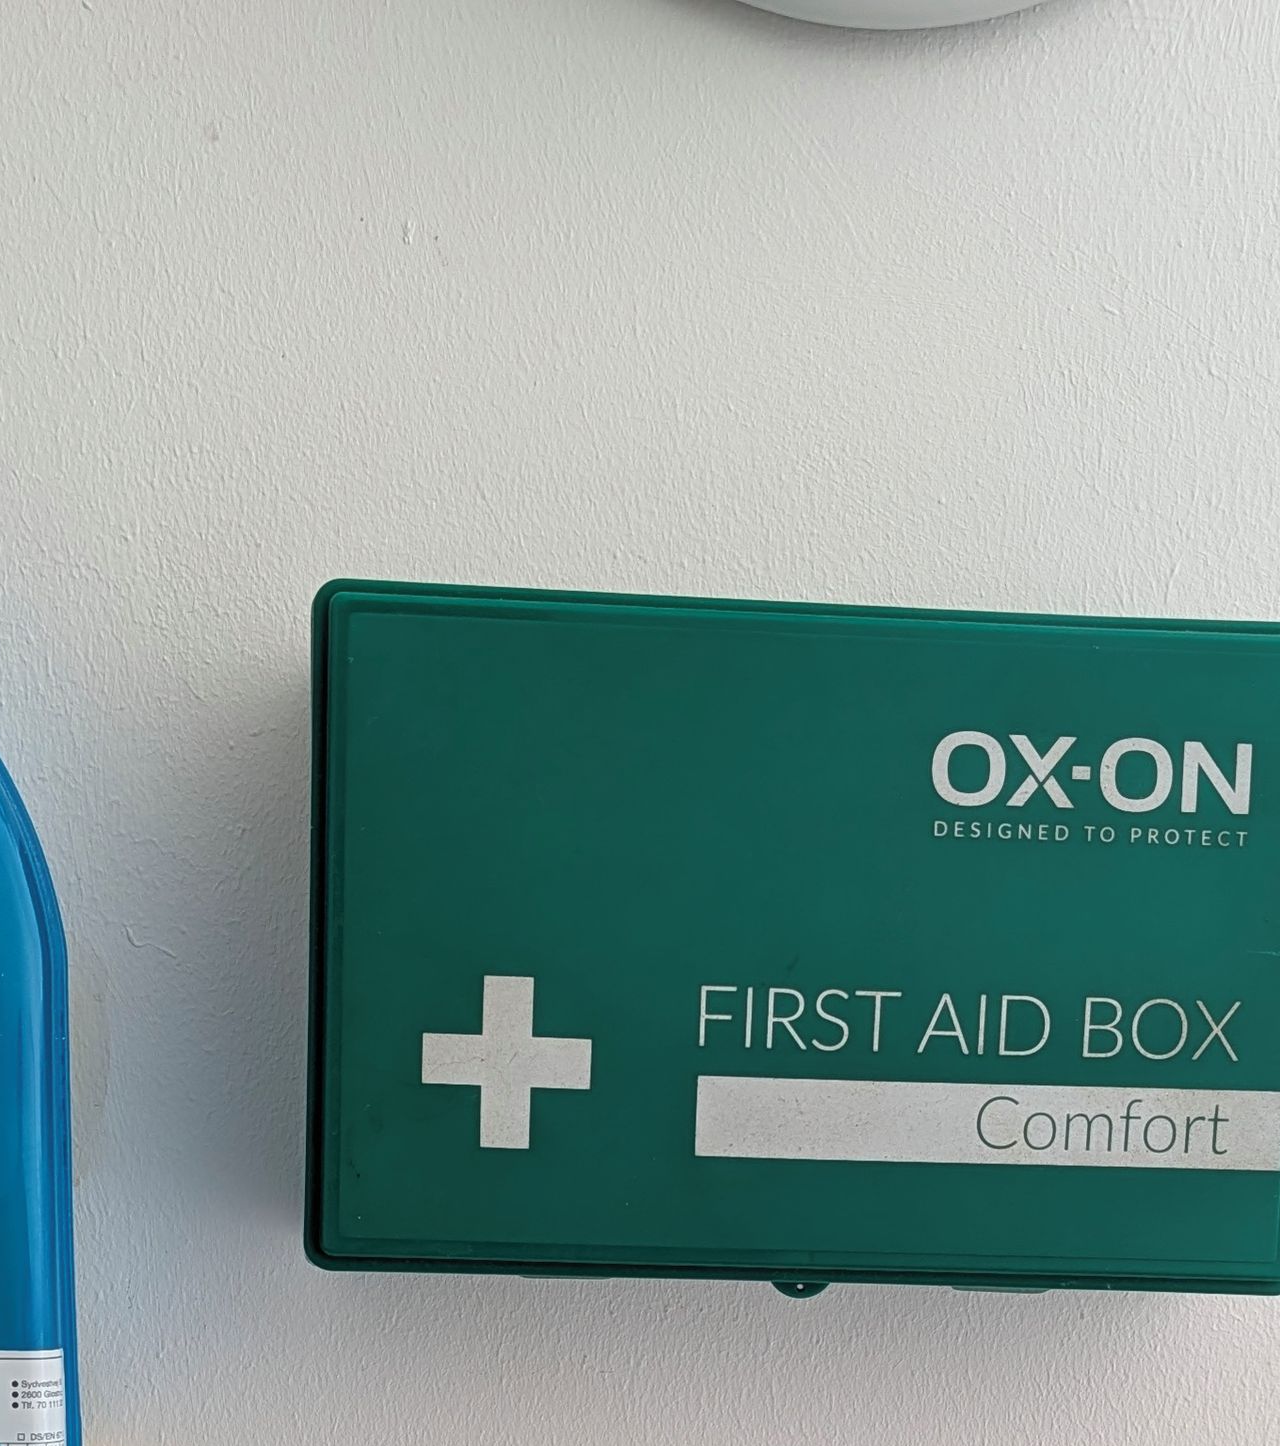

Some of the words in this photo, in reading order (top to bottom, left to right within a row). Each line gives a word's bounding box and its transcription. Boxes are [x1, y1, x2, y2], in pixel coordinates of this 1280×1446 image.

[931, 730, 1253, 815] OX-ON
[933, 820, 1070, 842] DESIGNED
[1084, 825, 1115, 842] TO
[1130, 827, 1248, 847] PROTECT
[698, 985, 902, 1052] FIRST
[917, 992, 1051, 1056] AID
[1081, 996, 1241, 1062] BOX
[975, 1095, 1229, 1155] Comfort
[21, 1390, 42, 1398] 2600
[37, 1401, 47, 1409] 70
